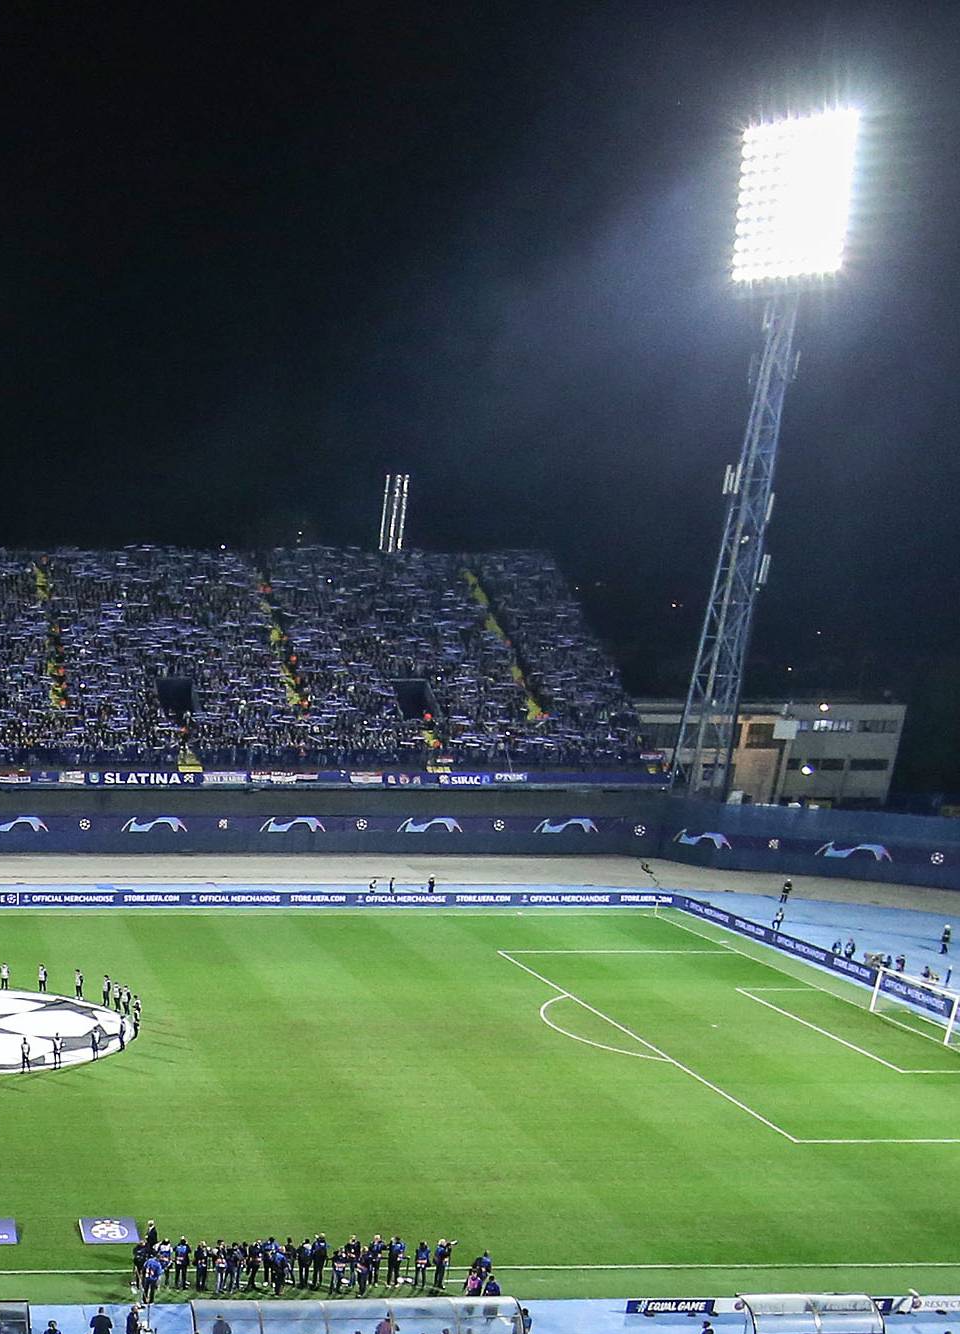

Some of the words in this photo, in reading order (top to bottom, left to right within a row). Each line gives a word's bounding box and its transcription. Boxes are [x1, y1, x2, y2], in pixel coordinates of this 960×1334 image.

[104, 772, 182, 785] SLATINA
[123, 894, 179, 902] STORE.UEFA.COM
[290, 894, 345, 902] STORE.UEFA.COM
[682, 1300, 706, 1312] GAME
